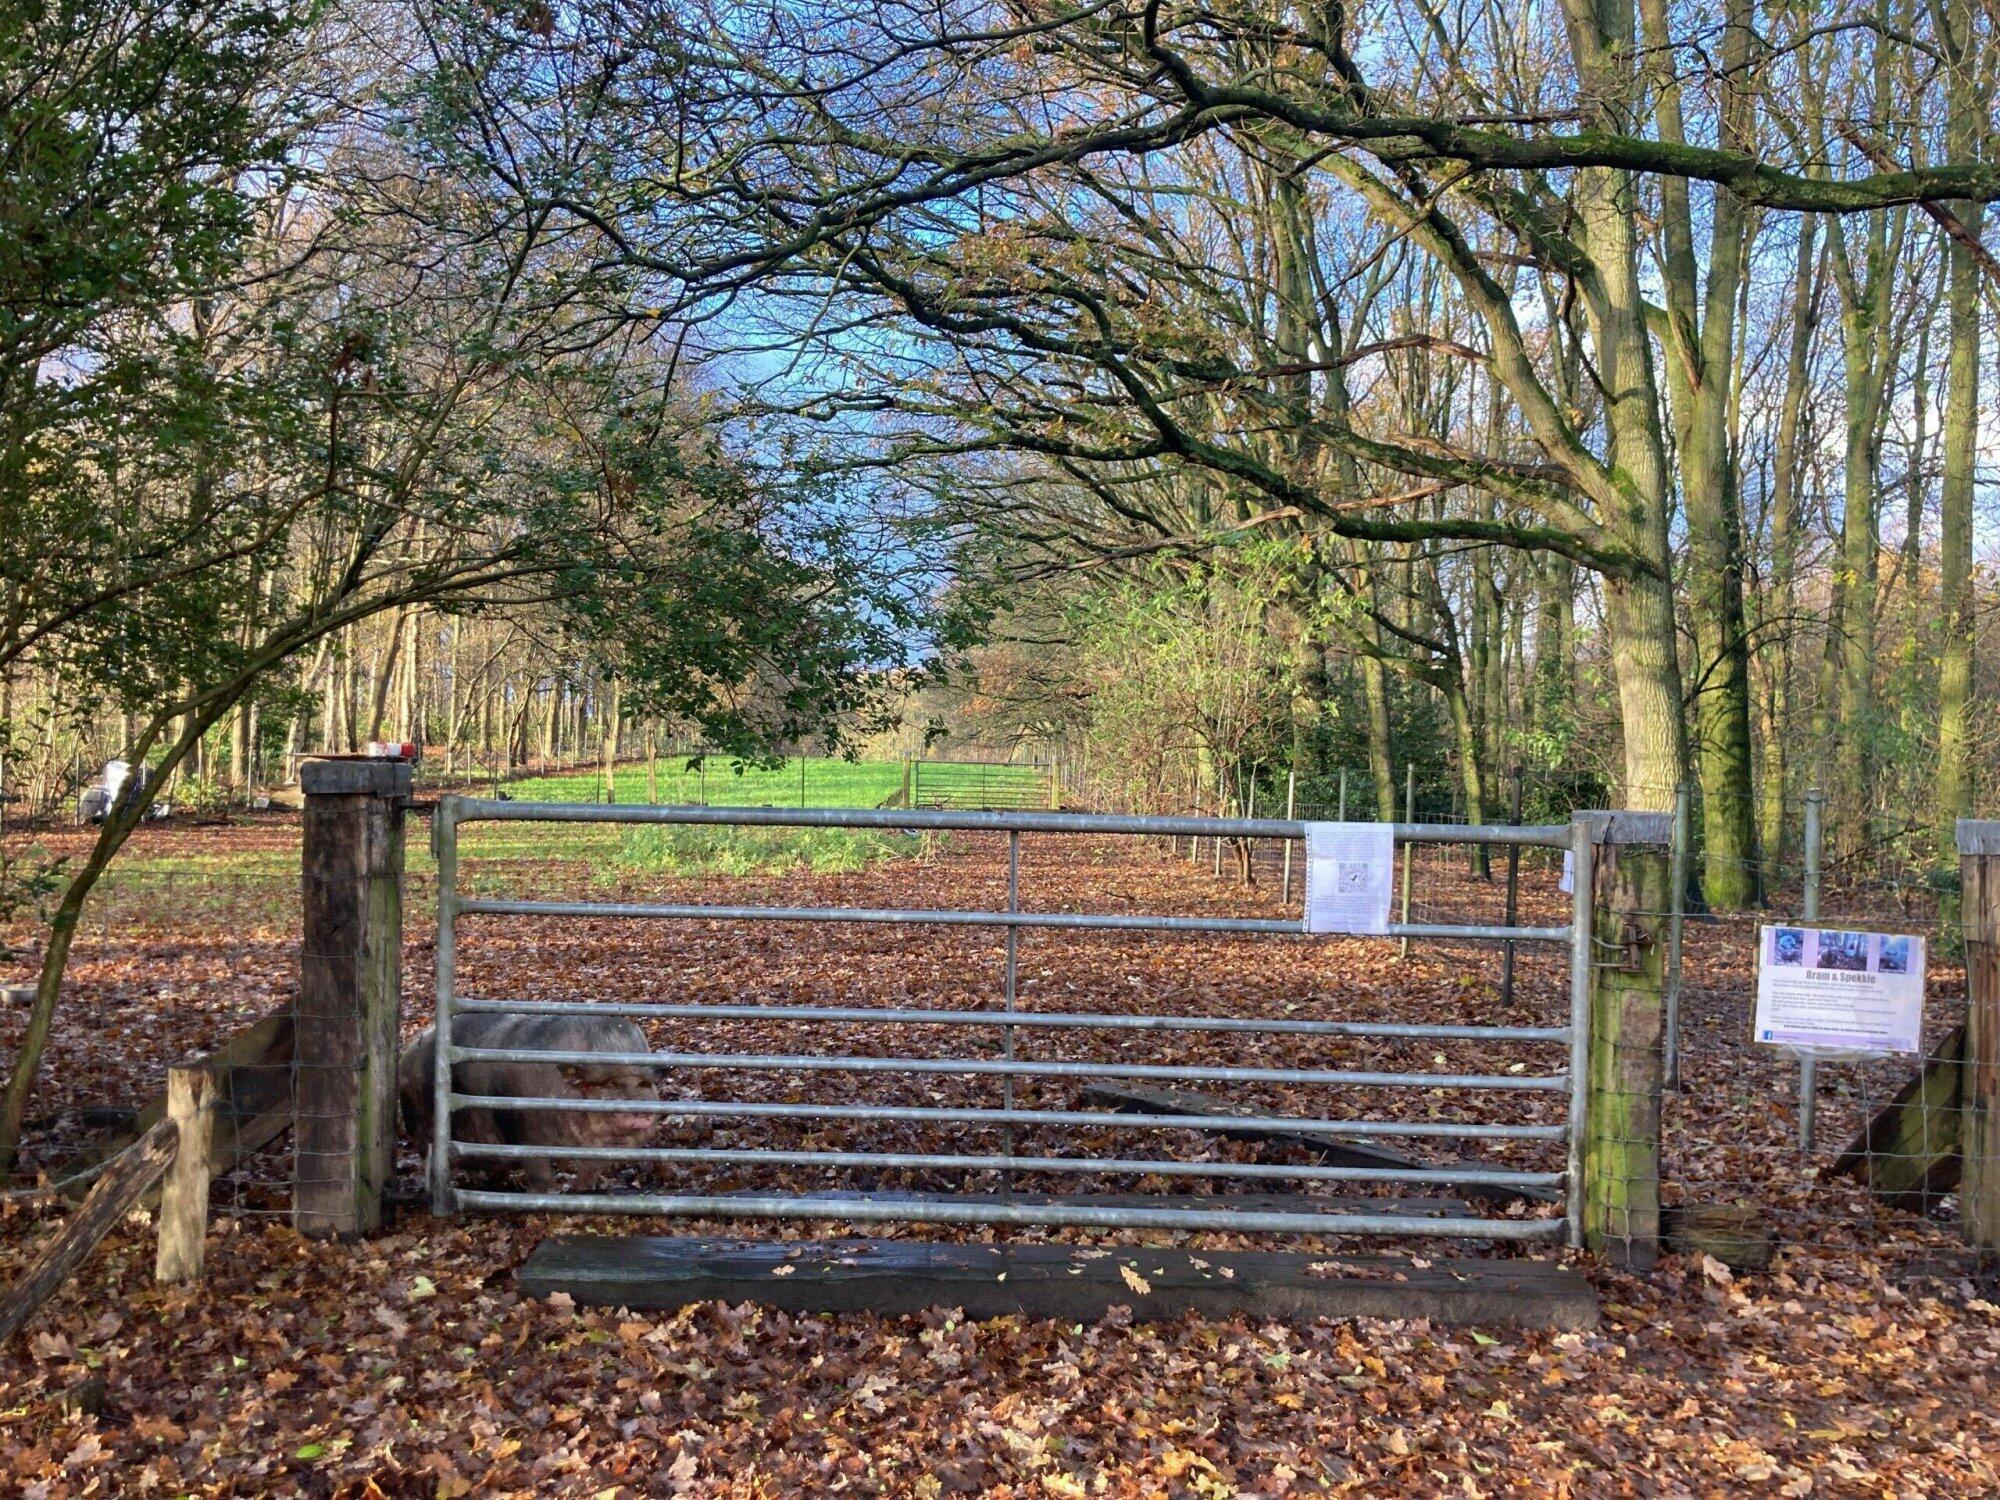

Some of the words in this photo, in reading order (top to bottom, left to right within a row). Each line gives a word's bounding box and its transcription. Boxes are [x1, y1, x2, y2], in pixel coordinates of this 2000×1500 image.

[1806, 970, 1830, 980] Bram
[1832, 972, 1838, 981] &
[1840, 971, 1876, 984] Spekkie
